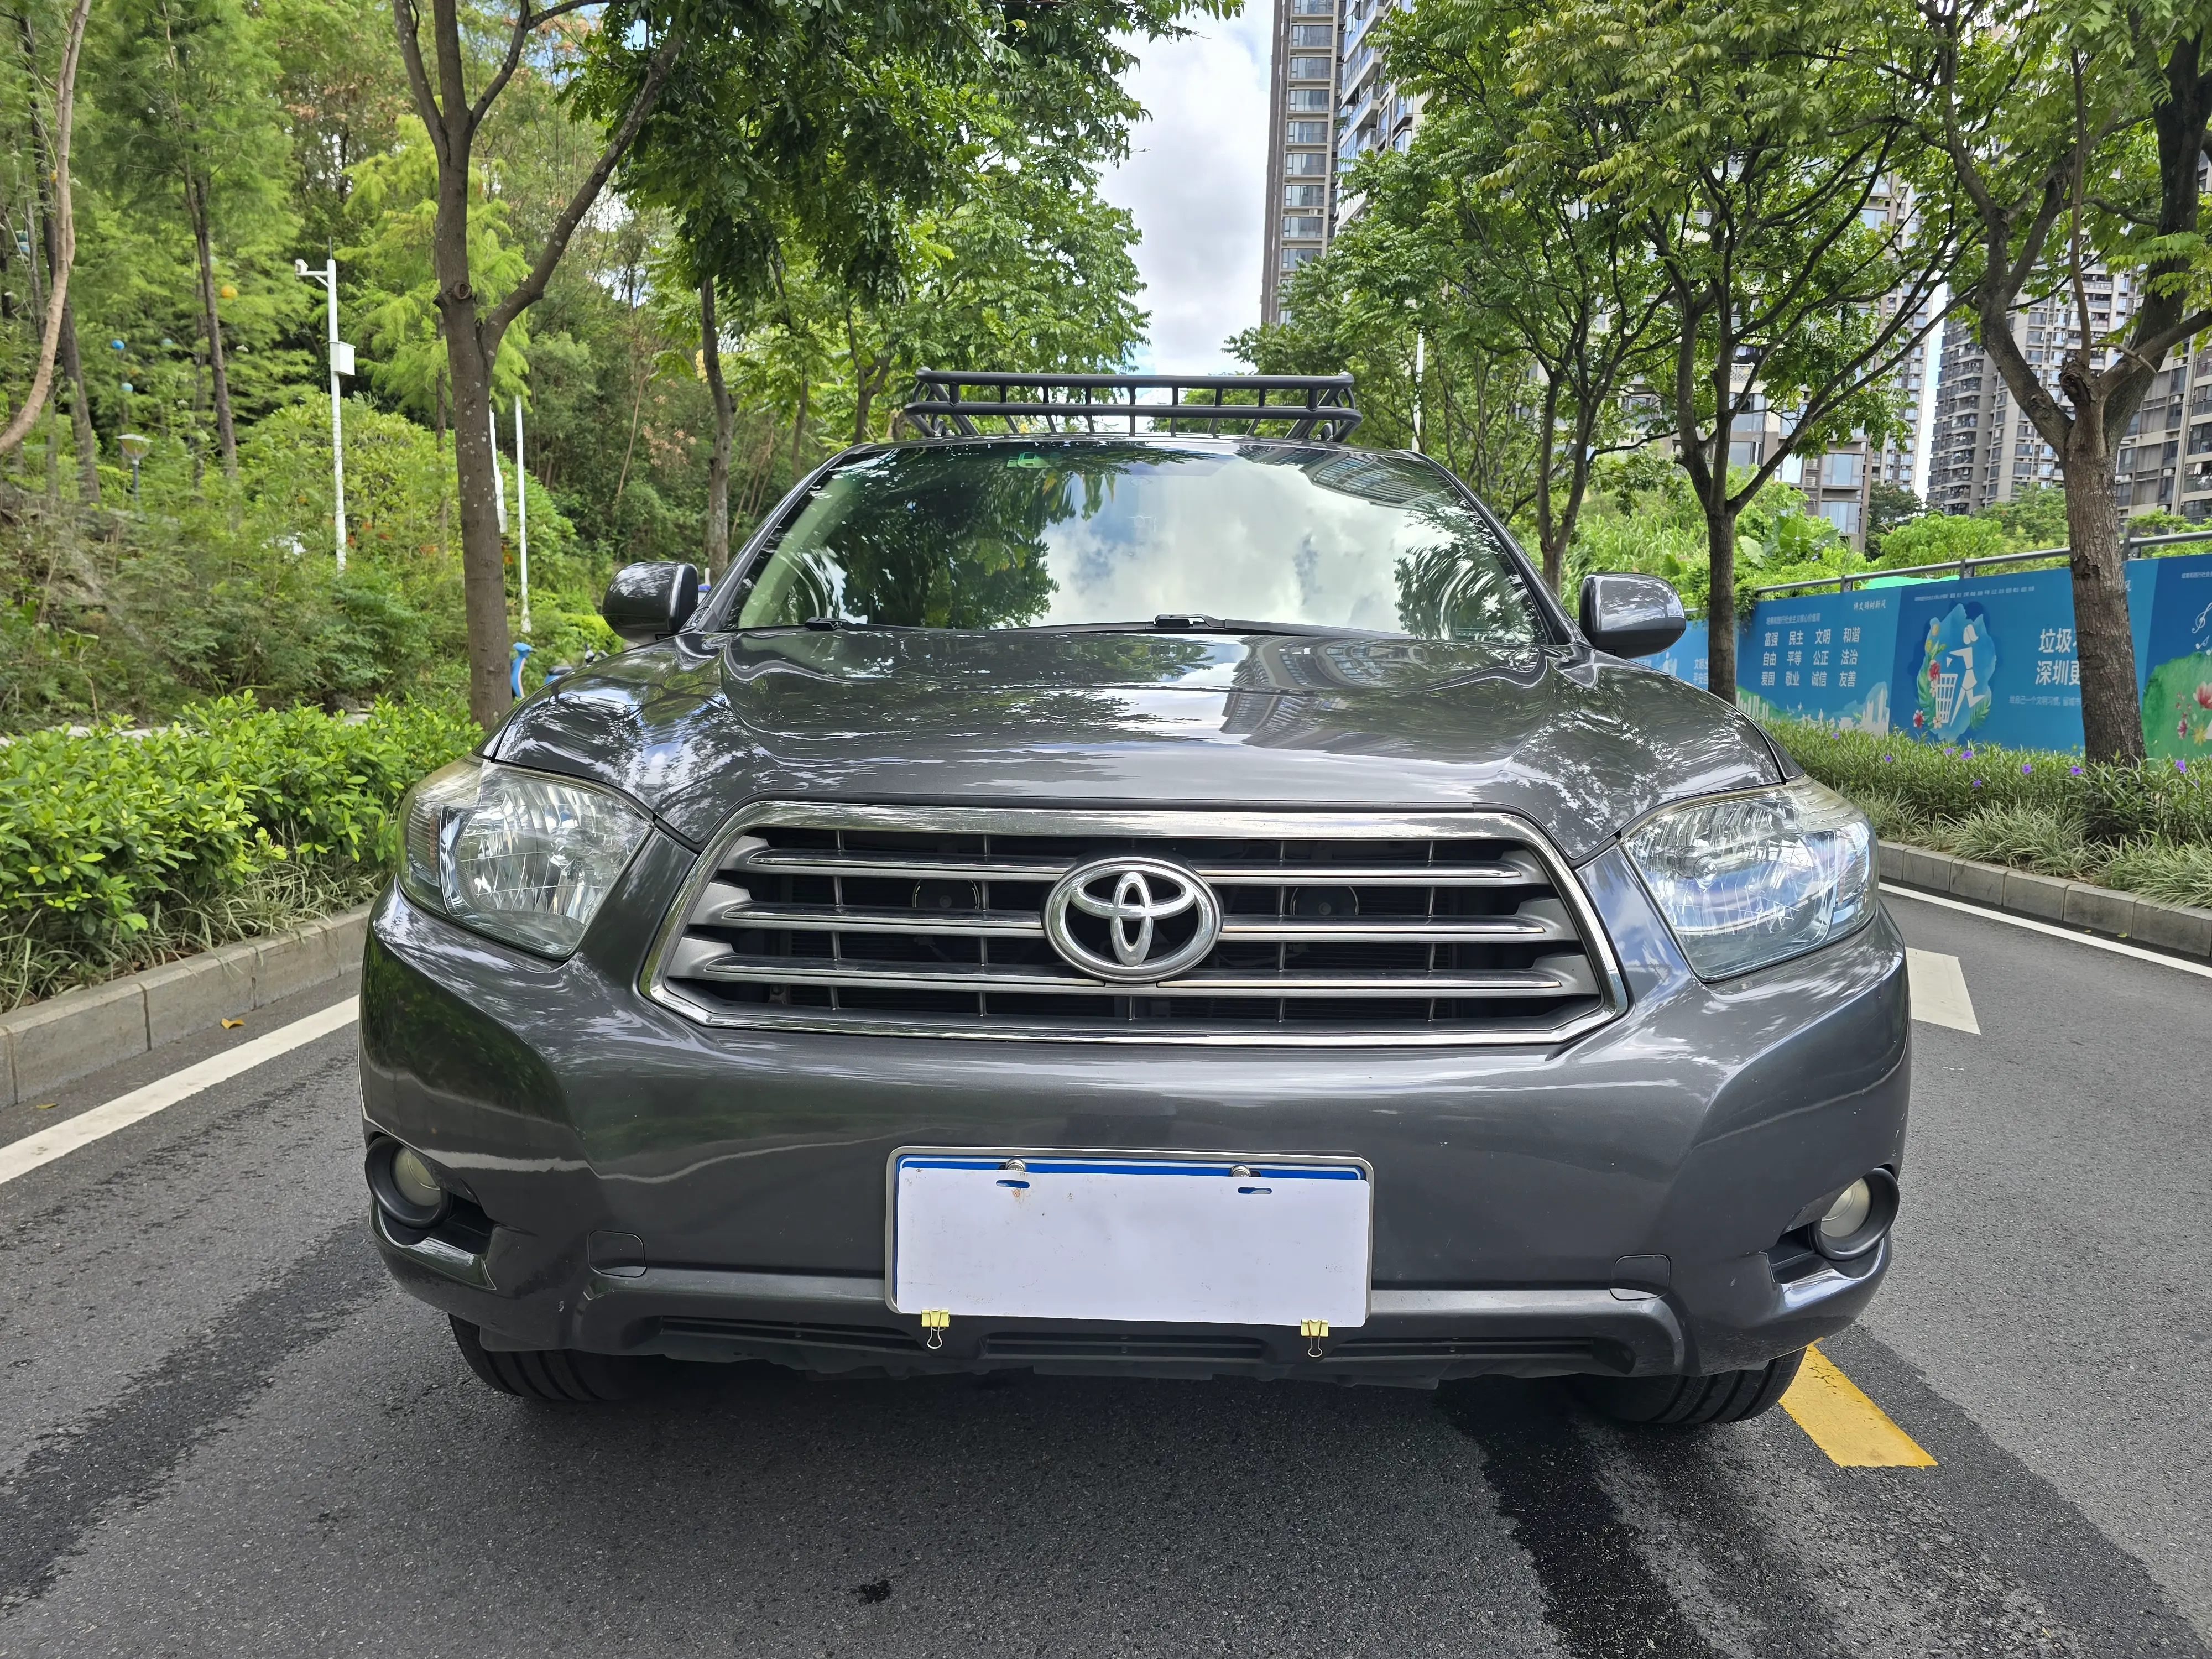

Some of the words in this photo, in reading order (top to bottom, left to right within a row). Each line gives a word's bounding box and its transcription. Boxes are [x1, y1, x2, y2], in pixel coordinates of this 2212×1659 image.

[1765, 632, 1778, 646] 富强
[1788, 630, 1804, 645] 民主
[1815, 629, 1831, 644] 文明
[1843, 627, 1860, 643] 和谐
[2038, 628, 2077, 653] 垃圾
[1763, 651, 1776, 666] 自由
[1787, 651, 1802, 666] 平等
[1813, 650, 1829, 665] 公正
[1840, 649, 1858, 665] 法治
[1761, 671, 1775, 686] 爱国
[1785, 671, 1800, 686] 敬业
[1811, 671, 1827, 687] 诚信
[1839, 671, 1856, 687] 友善
